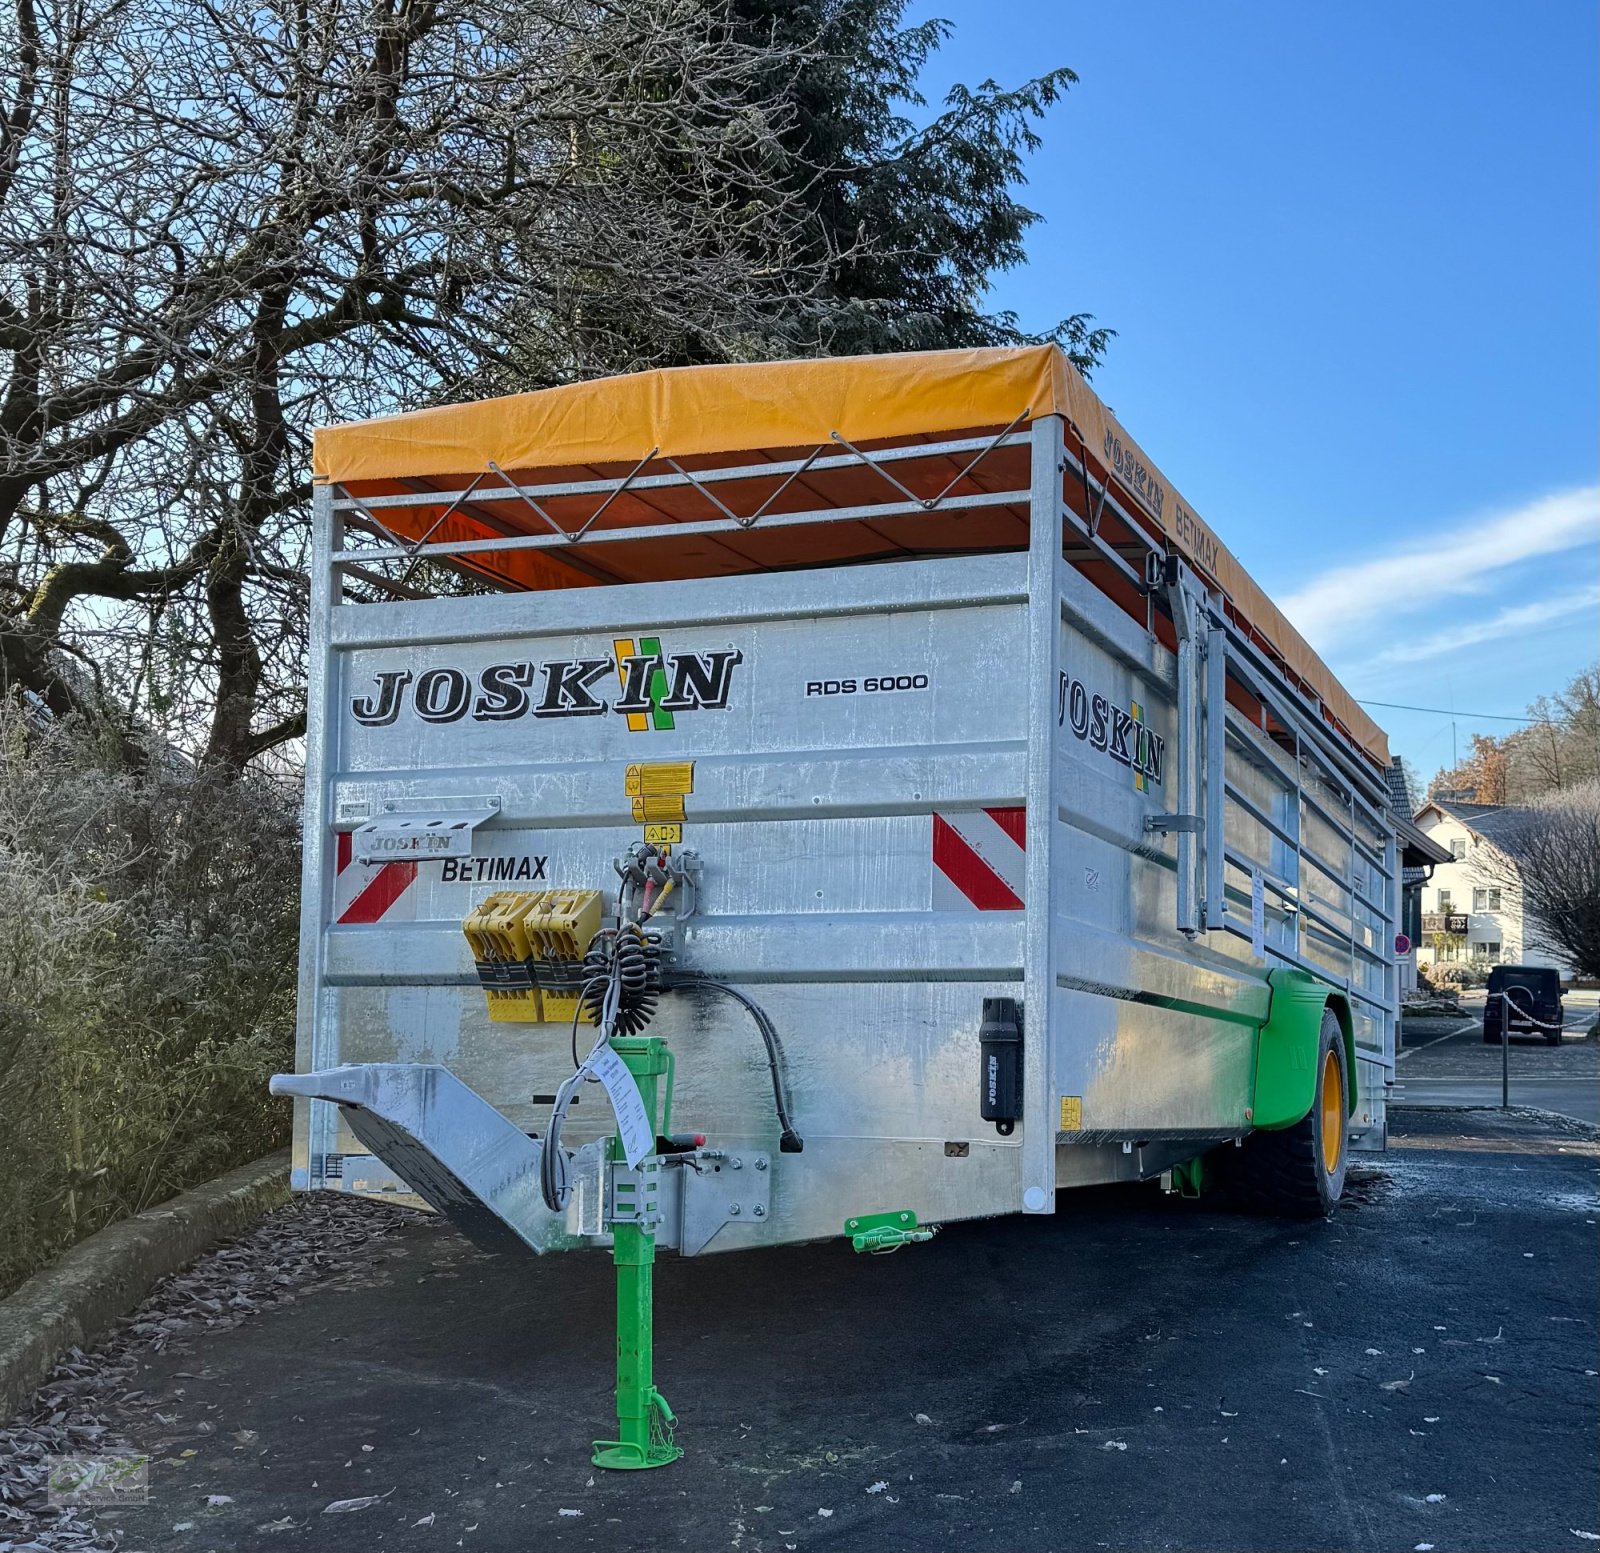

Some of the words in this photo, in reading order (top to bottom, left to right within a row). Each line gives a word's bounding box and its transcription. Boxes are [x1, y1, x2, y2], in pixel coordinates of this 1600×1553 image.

[1104, 428, 1164, 519] JOSKIN
[1176, 503, 1218, 576] BETIMAX
[350, 649, 743, 727] JOSKIN
[807, 680, 857, 696] RDS
[864, 675, 928, 692] 6000
[371, 835, 452, 851] JOSKIN
[442, 856, 548, 881] BETIMAX
[988, 1055, 998, 1106] JOSKIN
